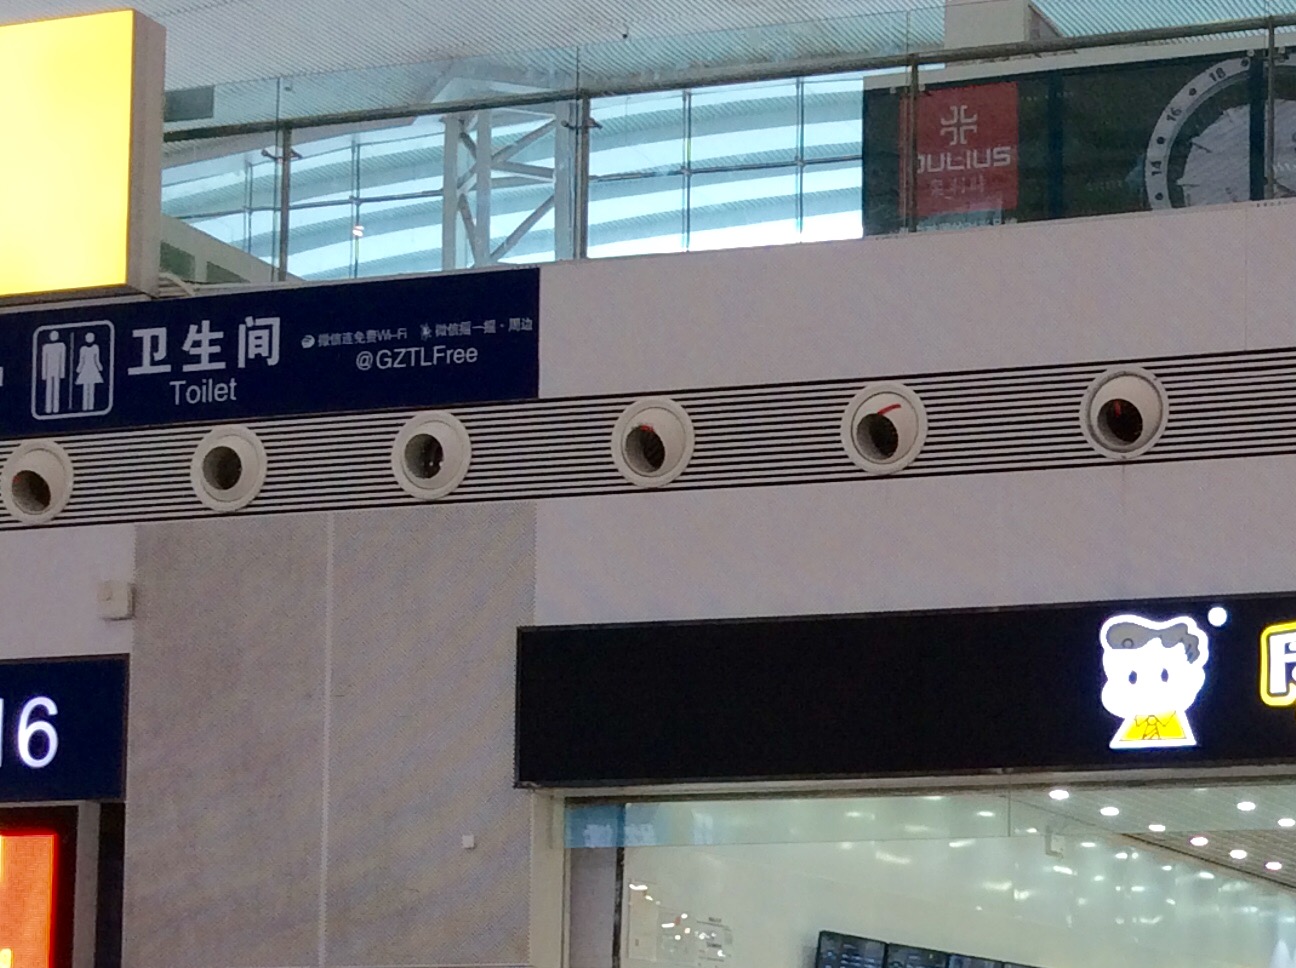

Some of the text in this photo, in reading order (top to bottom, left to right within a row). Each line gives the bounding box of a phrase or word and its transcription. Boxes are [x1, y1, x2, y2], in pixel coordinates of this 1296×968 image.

[127, 315, 281, 376] 卫生间
[356, 344, 479, 371] @GZTLFree
[169, 377, 237, 405] Toilet
